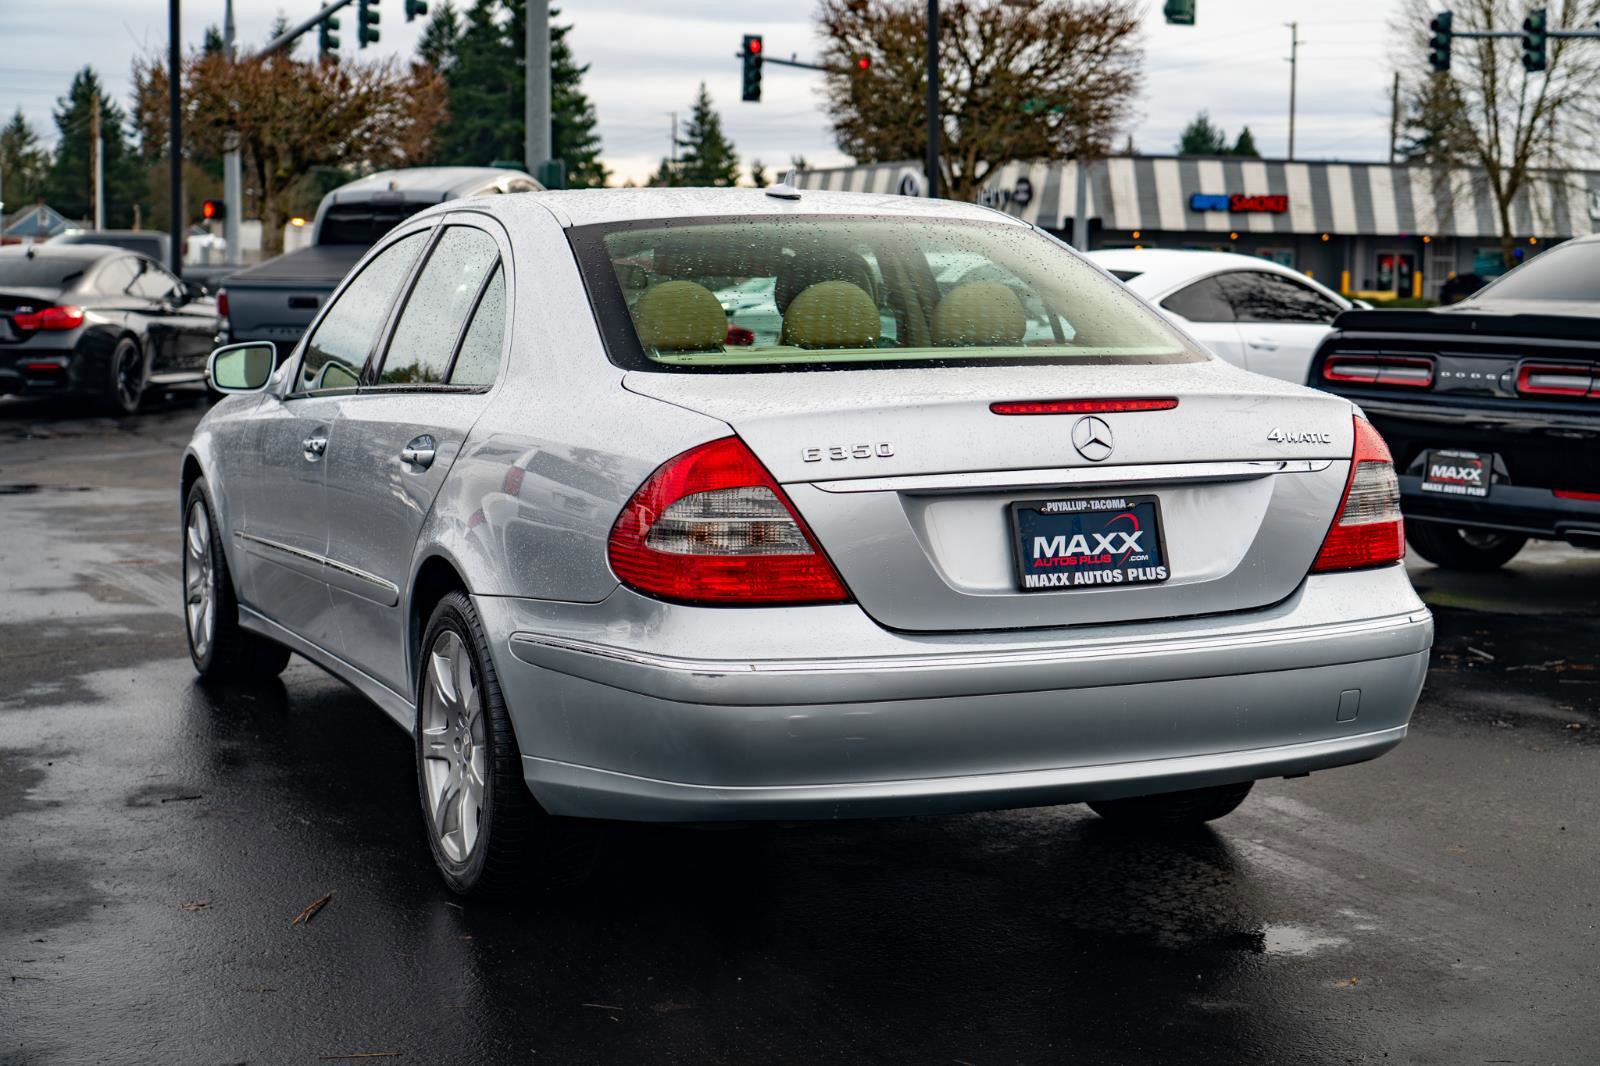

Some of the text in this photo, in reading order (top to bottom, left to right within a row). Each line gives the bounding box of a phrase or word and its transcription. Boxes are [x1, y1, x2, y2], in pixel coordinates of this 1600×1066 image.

[1231, 194, 1288, 213] SMOKE
[1440, 371, 1511, 380] DODGE
[1430, 465, 1482, 481] MAXX
[1033, 530, 1144, 559] MAXX
[1033, 554, 1112, 567] AUTOS PLUS
[1025, 566, 1167, 588] MAXX AUTOS PLUS
